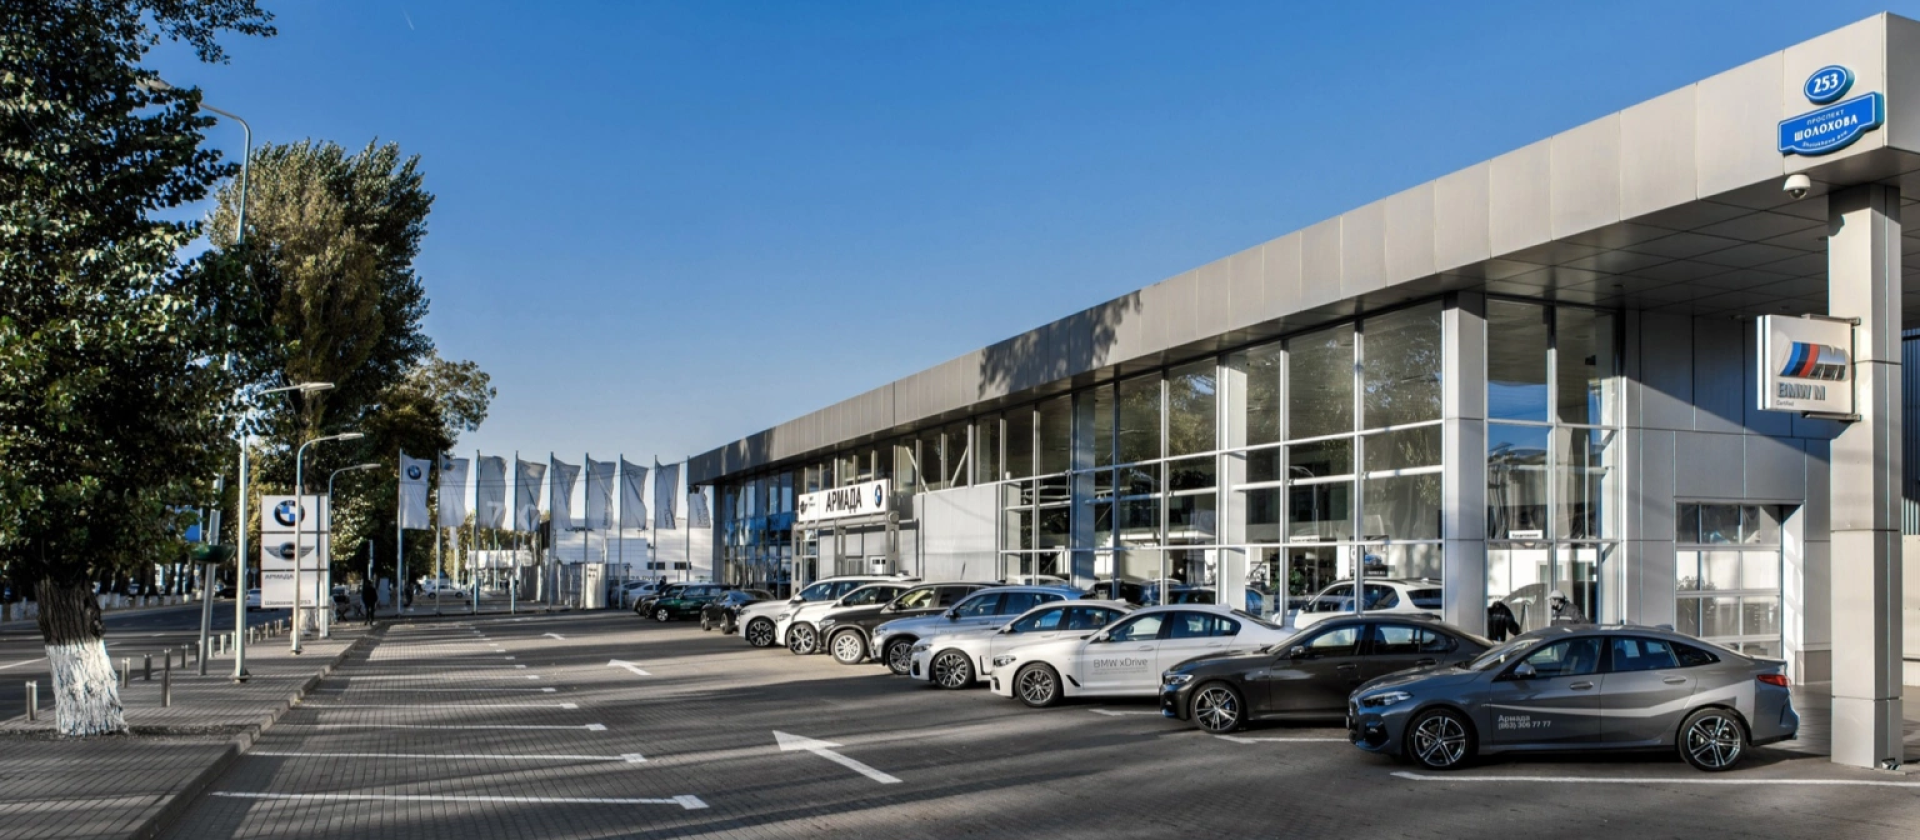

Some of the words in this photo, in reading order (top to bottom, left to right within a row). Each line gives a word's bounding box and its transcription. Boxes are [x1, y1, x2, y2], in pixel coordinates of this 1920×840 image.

[1813, 73, 1839, 94] 253
[1806, 109, 1845, 126] ПРОСПЕКТ
[1794, 114, 1859, 142] ШОЛОХОВА
[1777, 382, 1812, 400] BMW
[1814, 384, 1826, 401] M
[825, 486, 862, 514] АРМАДА
[1093, 658, 1117, 669] BMW
[1119, 657, 1149, 668] xDrive
[1498, 714, 1531, 724] Армада
[1532, 720, 1541, 729] 77
[1543, 720, 1552, 728] 77
